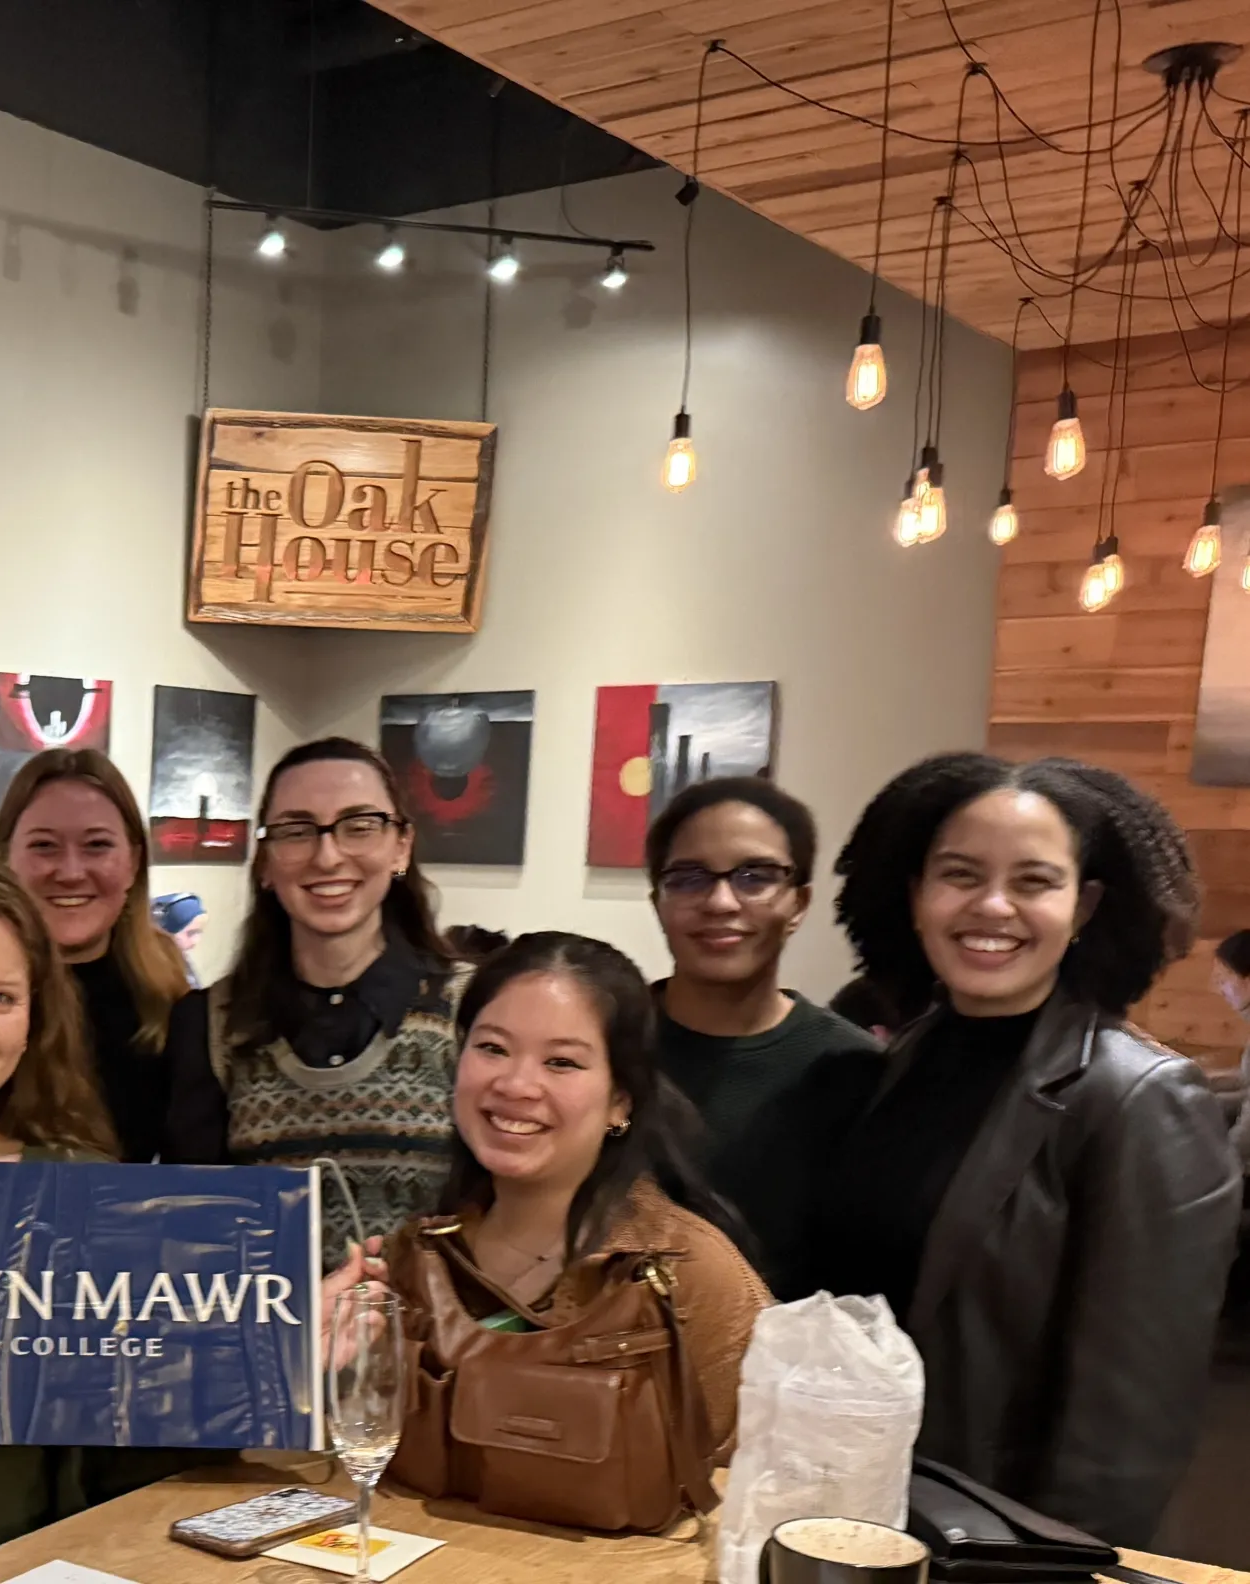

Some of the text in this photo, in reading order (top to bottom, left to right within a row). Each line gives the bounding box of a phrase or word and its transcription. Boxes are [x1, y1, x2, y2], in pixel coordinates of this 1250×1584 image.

[224, 438, 449, 534] the Oak
[221, 510, 468, 603] House
[71, 1270, 303, 1326] MAWR
[9, 1335, 165, 1358] COLLEGE
